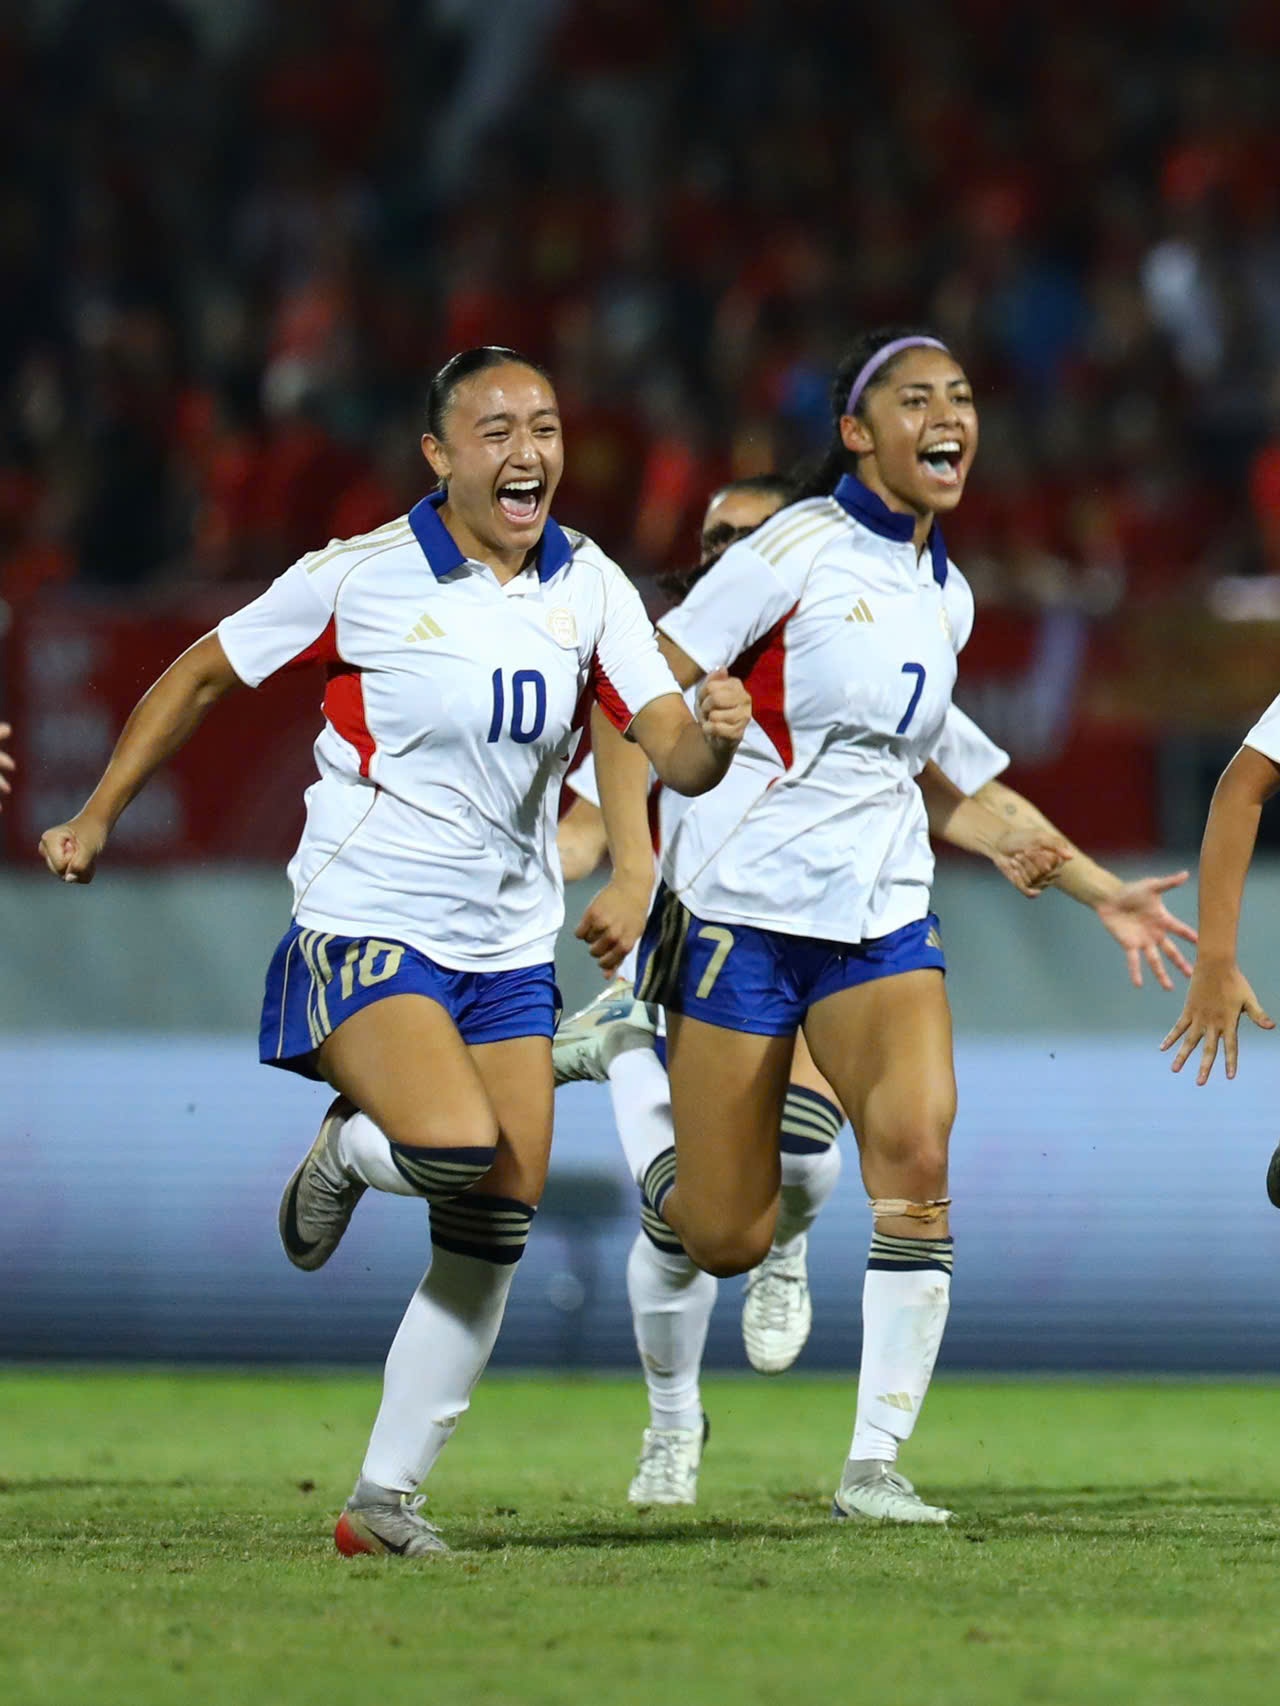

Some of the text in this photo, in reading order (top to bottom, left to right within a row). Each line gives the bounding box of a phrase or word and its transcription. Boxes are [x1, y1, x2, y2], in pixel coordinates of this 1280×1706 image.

[488, 668, 547, 744] 10
[895, 662, 926, 735] 7
[341, 939, 405, 1000] 10
[697, 925, 734, 999] 7
